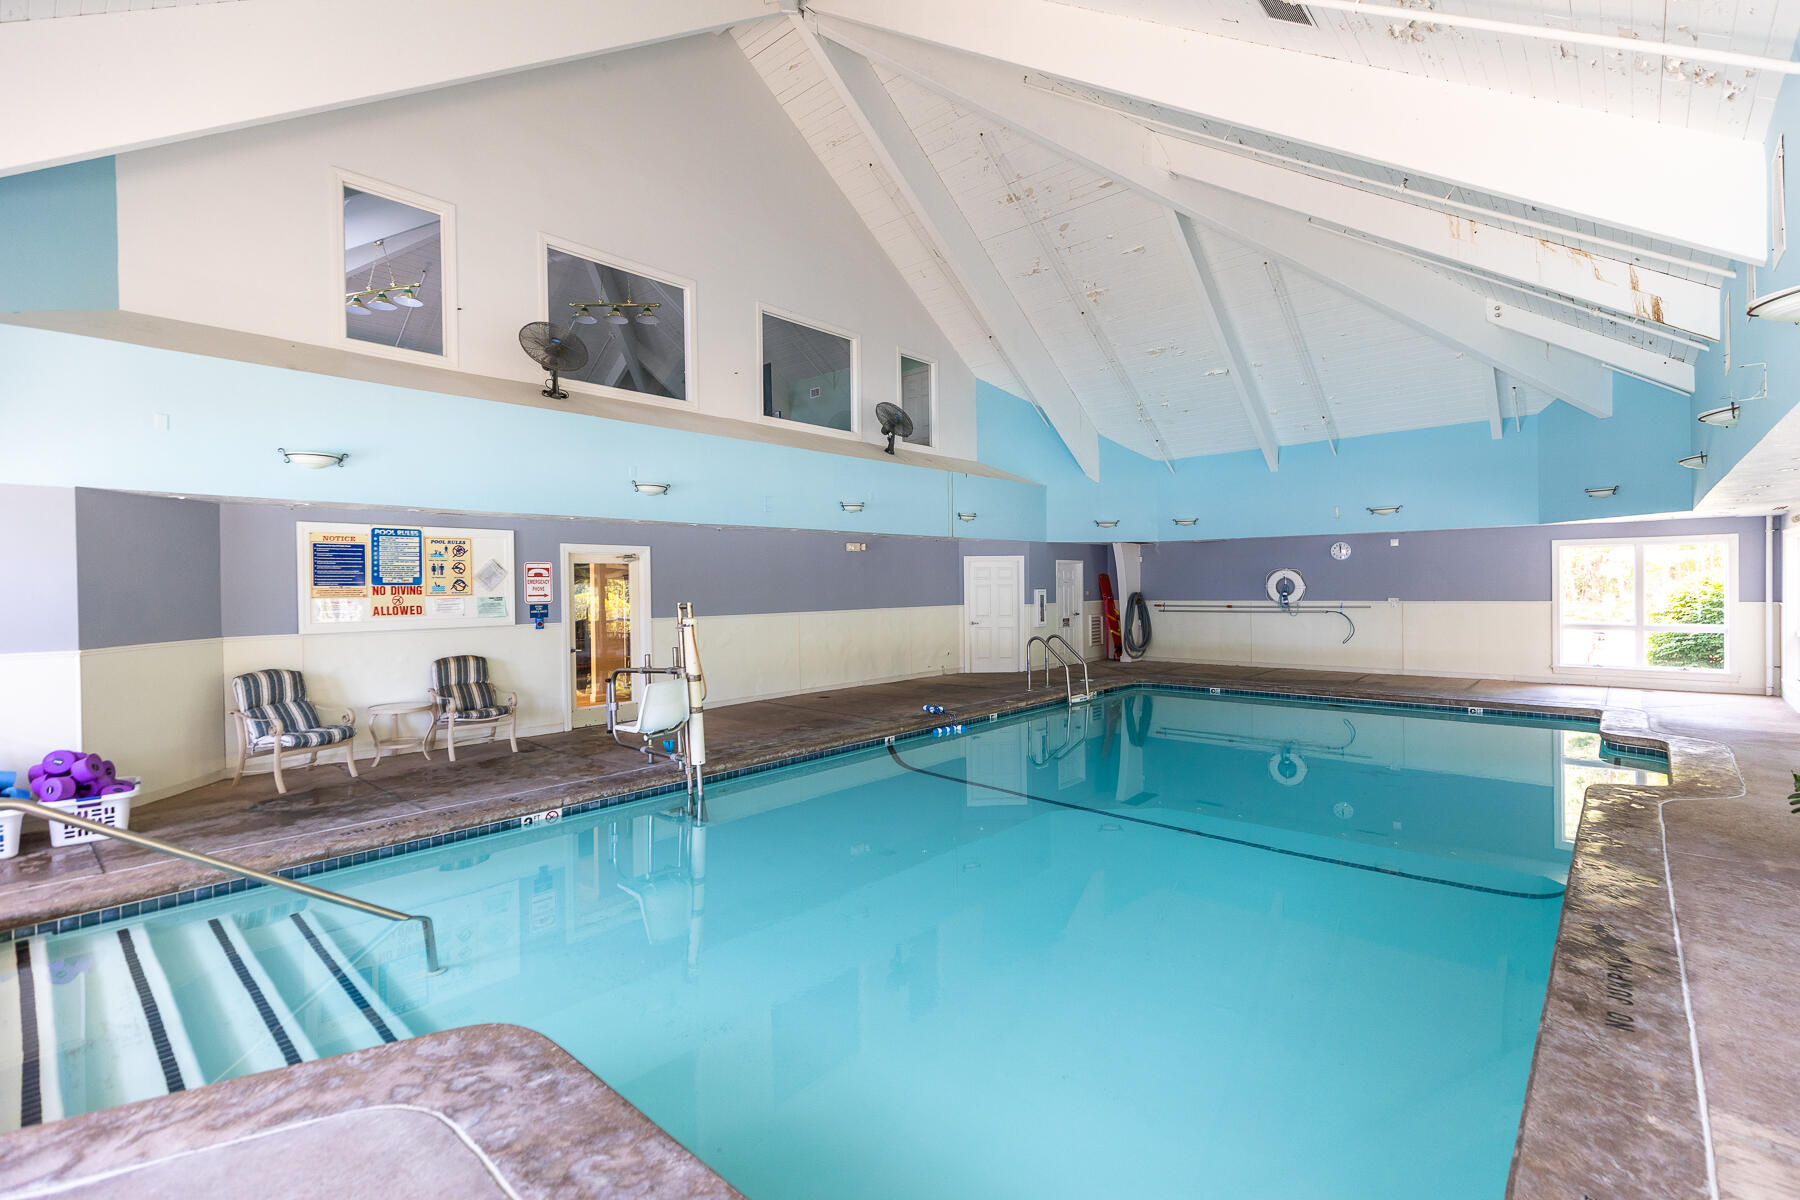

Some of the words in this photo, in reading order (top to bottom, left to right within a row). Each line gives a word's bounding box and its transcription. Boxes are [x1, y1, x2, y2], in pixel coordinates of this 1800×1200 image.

[372, 586, 386, 596] NO
[390, 586, 422, 595] DIVING
[372, 605, 423, 616] ALLOWED
[1605, 1011, 1635, 1032] NO
